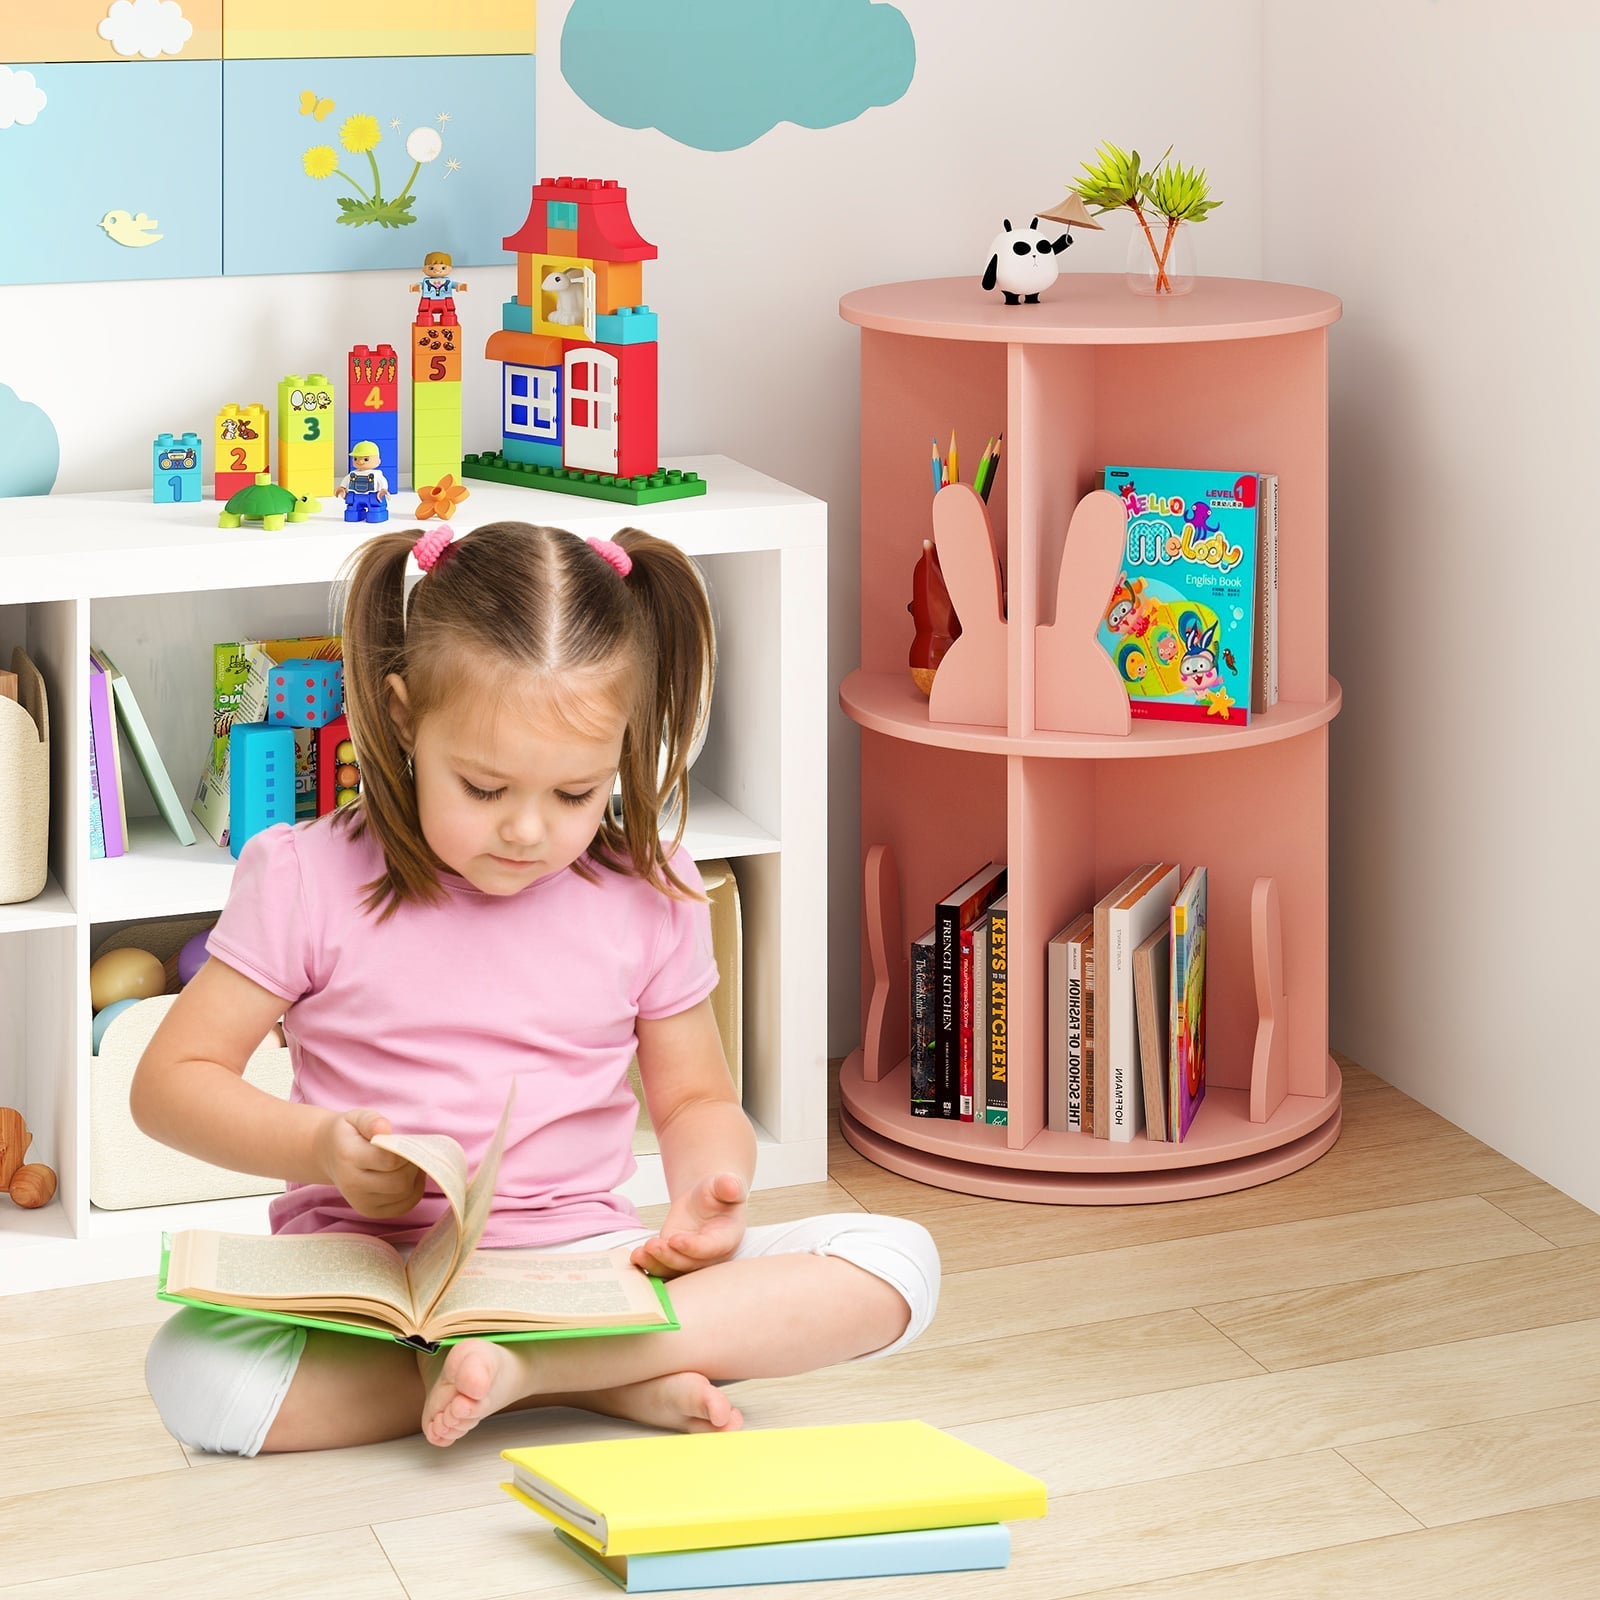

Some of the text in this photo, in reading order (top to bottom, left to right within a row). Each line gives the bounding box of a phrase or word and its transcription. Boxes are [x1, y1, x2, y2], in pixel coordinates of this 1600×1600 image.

[429, 355, 446, 381] 5
[364, 386, 384, 409] 4
[302, 416, 320, 441] 3
[230, 447, 247, 471] 2
[168, 476, 182, 502] 1
[1206, 485, 1244, 499] LEVEL 1
[1123, 493, 1184, 519] HELLO
[1186, 574, 1242, 587] English Book
[992, 917, 1006, 971] KEYS
[916, 960, 927, 972] The
[943, 919, 952, 1031] FRENCH KITCHEN
[915, 973, 927, 992] Green
[915, 993, 927, 1018] Kitchen
[992, 981, 1006, 1083] KITCHEN
